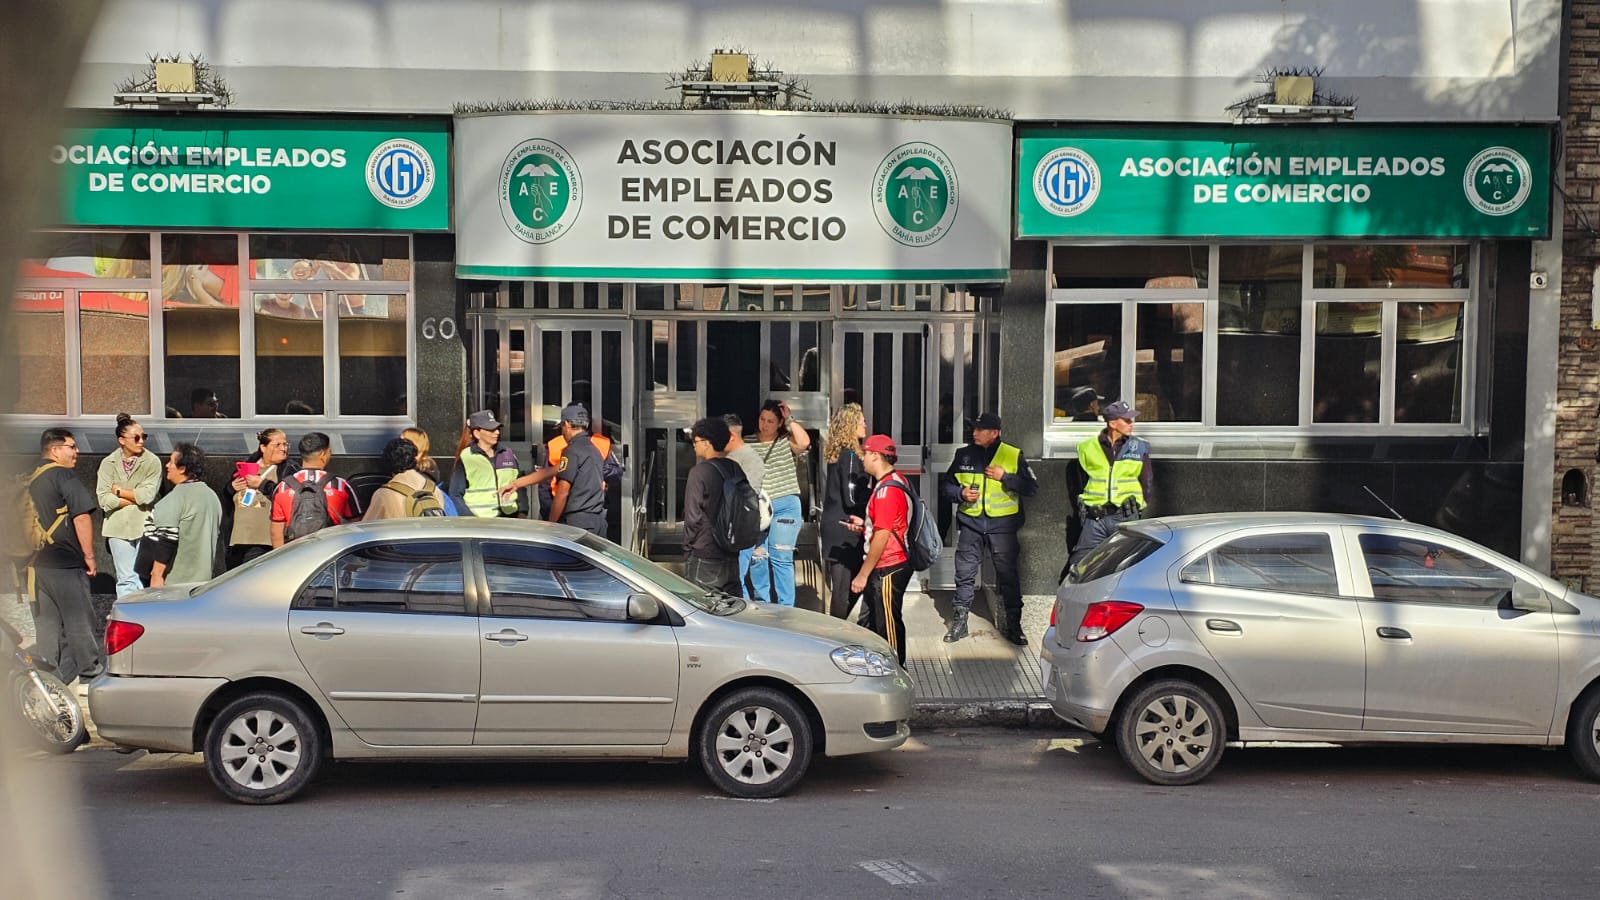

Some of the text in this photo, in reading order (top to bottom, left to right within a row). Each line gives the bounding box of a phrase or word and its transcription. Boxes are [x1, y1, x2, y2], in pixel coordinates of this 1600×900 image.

[50, 141, 347, 168] OCIACIÓN EMPLEADOS
[616, 133, 836, 166] ASOCIACIÓN
[379, 152, 421, 194] CGT
[517, 144, 555, 158] EMPLEADOS
[555, 151, 565, 162] DE
[563, 160, 578, 201] COMERCIO
[1119, 151, 1446, 177] ASOCIACIÓN EMPLEADOS
[88, 172, 271, 194] DE COMERCIO
[896, 147, 936, 161] EMPLEADOS
[936, 155, 945, 166] DE
[943, 165, 956, 205] COMERCIO
[1047, 161, 1088, 202] CGT
[1482, 174, 1513, 184] A E
[518, 181, 558, 196] A E
[621, 177, 833, 203] EMPLEADOS
[897, 184, 938, 199] A E
[1194, 183, 1371, 203] DE COMERCIO
[1493, 190, 1502, 200] C
[532, 207, 543, 222] C
[912, 210, 924, 225] C
[535, 223, 564, 241] BLANCA
[608, 215, 846, 241] DE COMERCIO
[915, 226, 943, 243] BLANCA
[422, 317, 456, 340] 60
